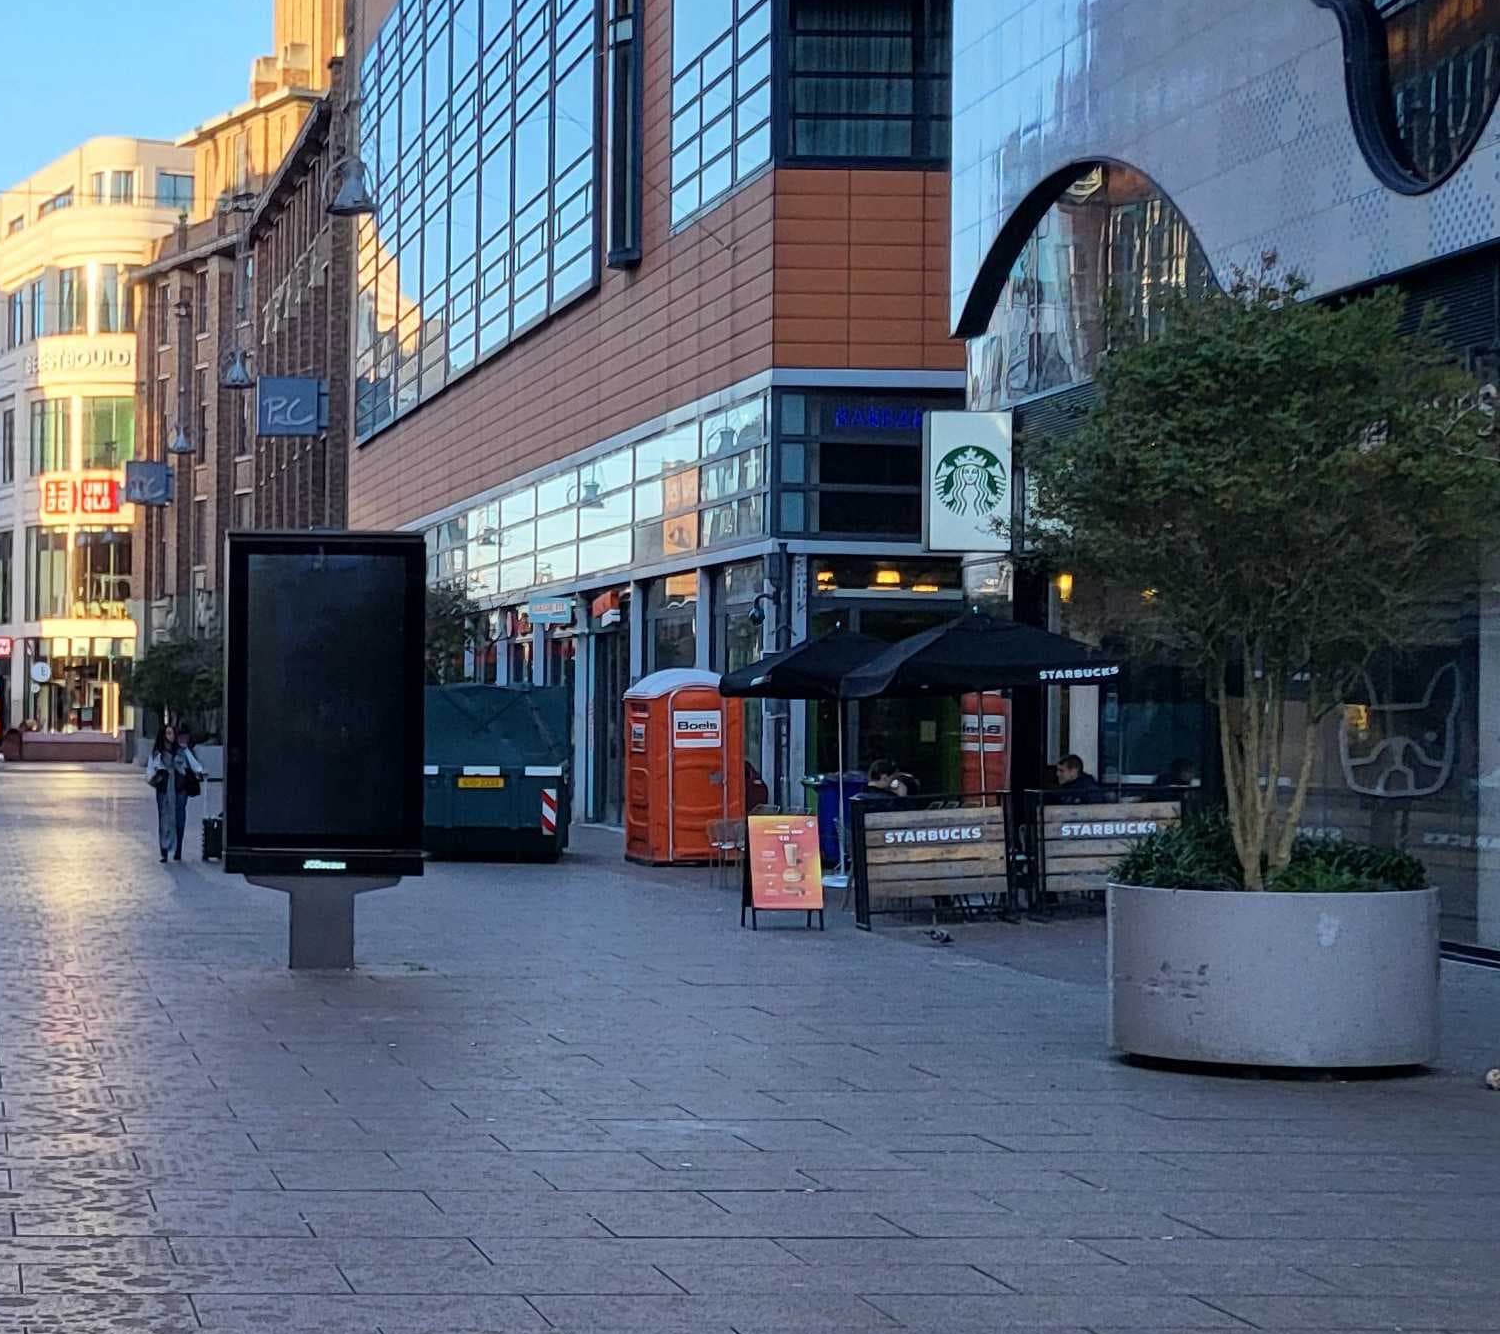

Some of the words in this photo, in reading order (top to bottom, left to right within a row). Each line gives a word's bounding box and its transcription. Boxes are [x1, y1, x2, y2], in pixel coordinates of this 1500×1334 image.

[1039, 667, 1119, 680] STARBUCKS
[884, 827, 982, 844] STARBUCKS
[1061, 821, 1157, 837] STARBUCKS
